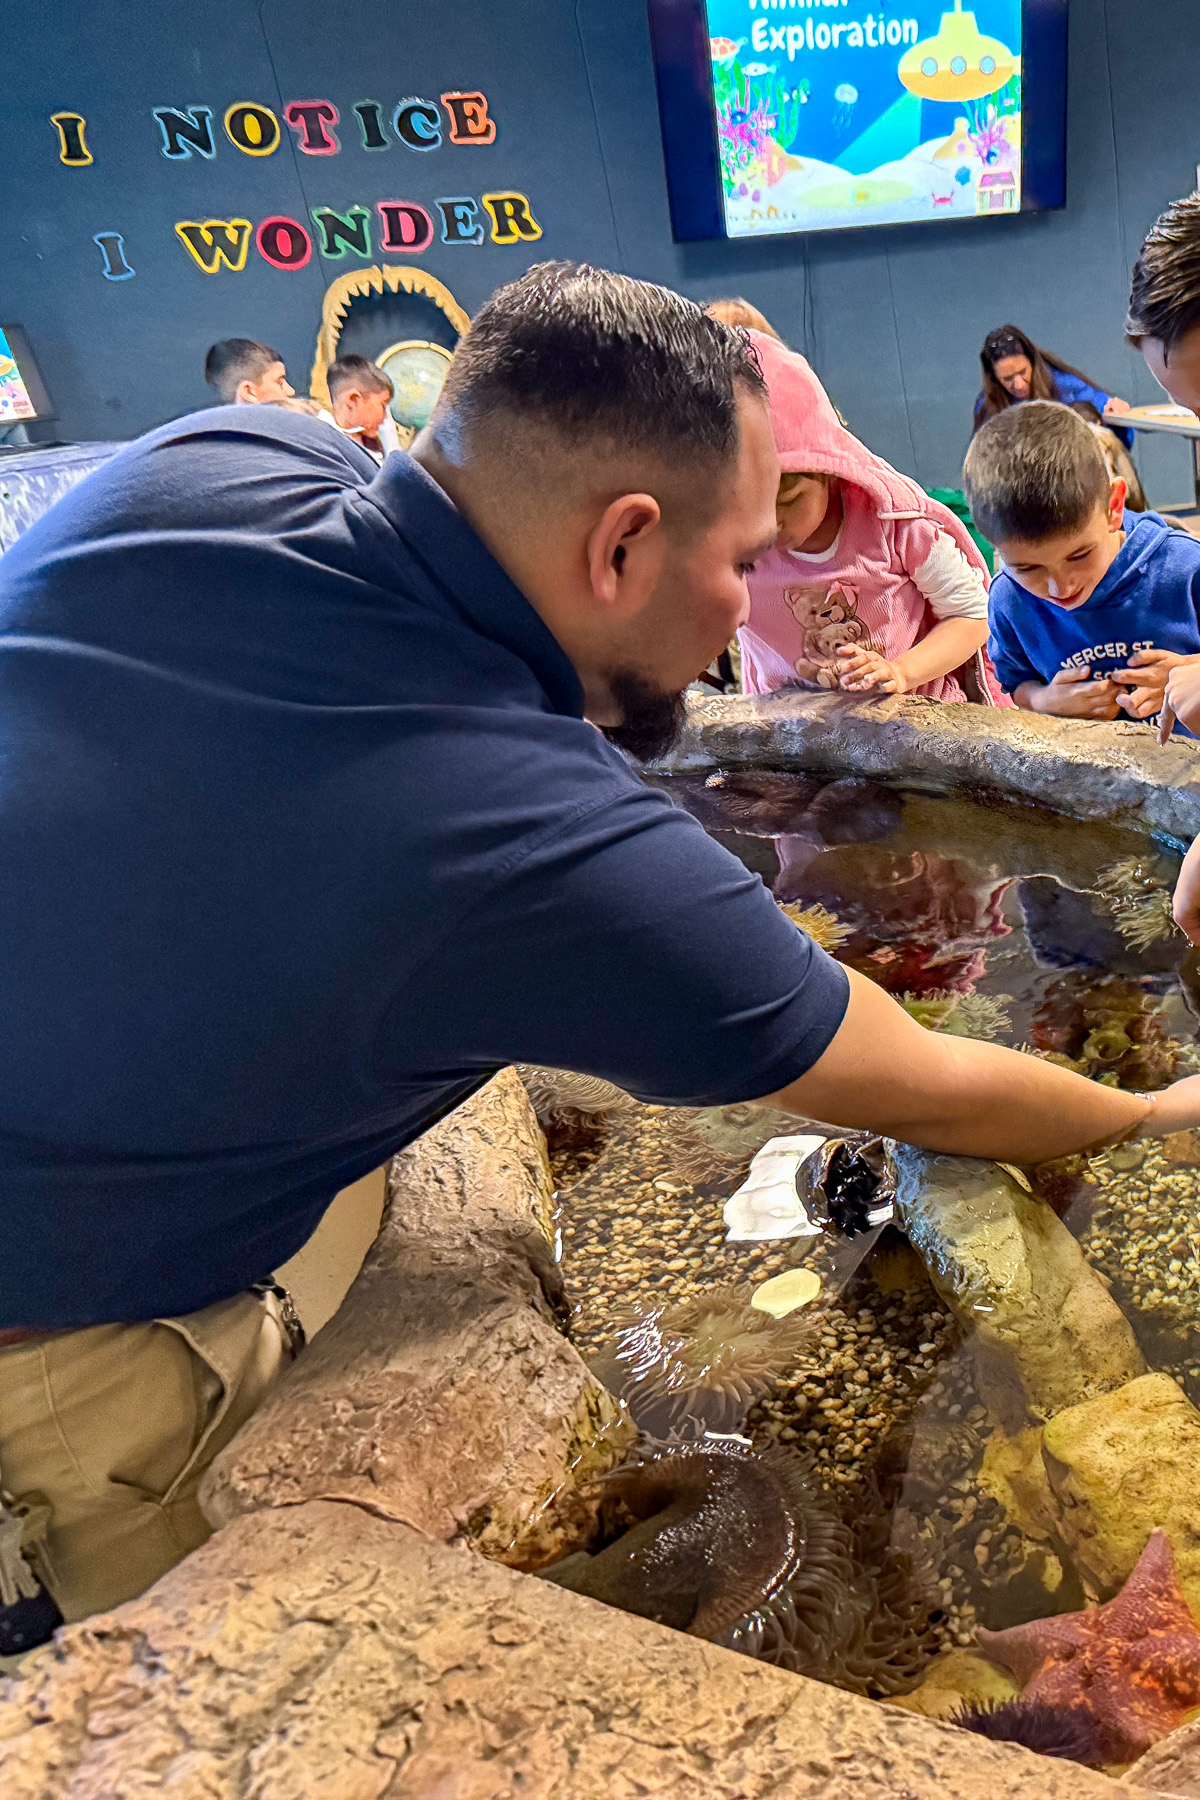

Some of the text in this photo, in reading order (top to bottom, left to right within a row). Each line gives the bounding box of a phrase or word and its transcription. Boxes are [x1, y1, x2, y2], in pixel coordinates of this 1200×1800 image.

[751, 14, 918, 61] Exploration
[51, 90, 497, 166] I NOTICE
[93, 190, 543, 282] I WONDER
[1060, 641, 1129, 670] MERCER
